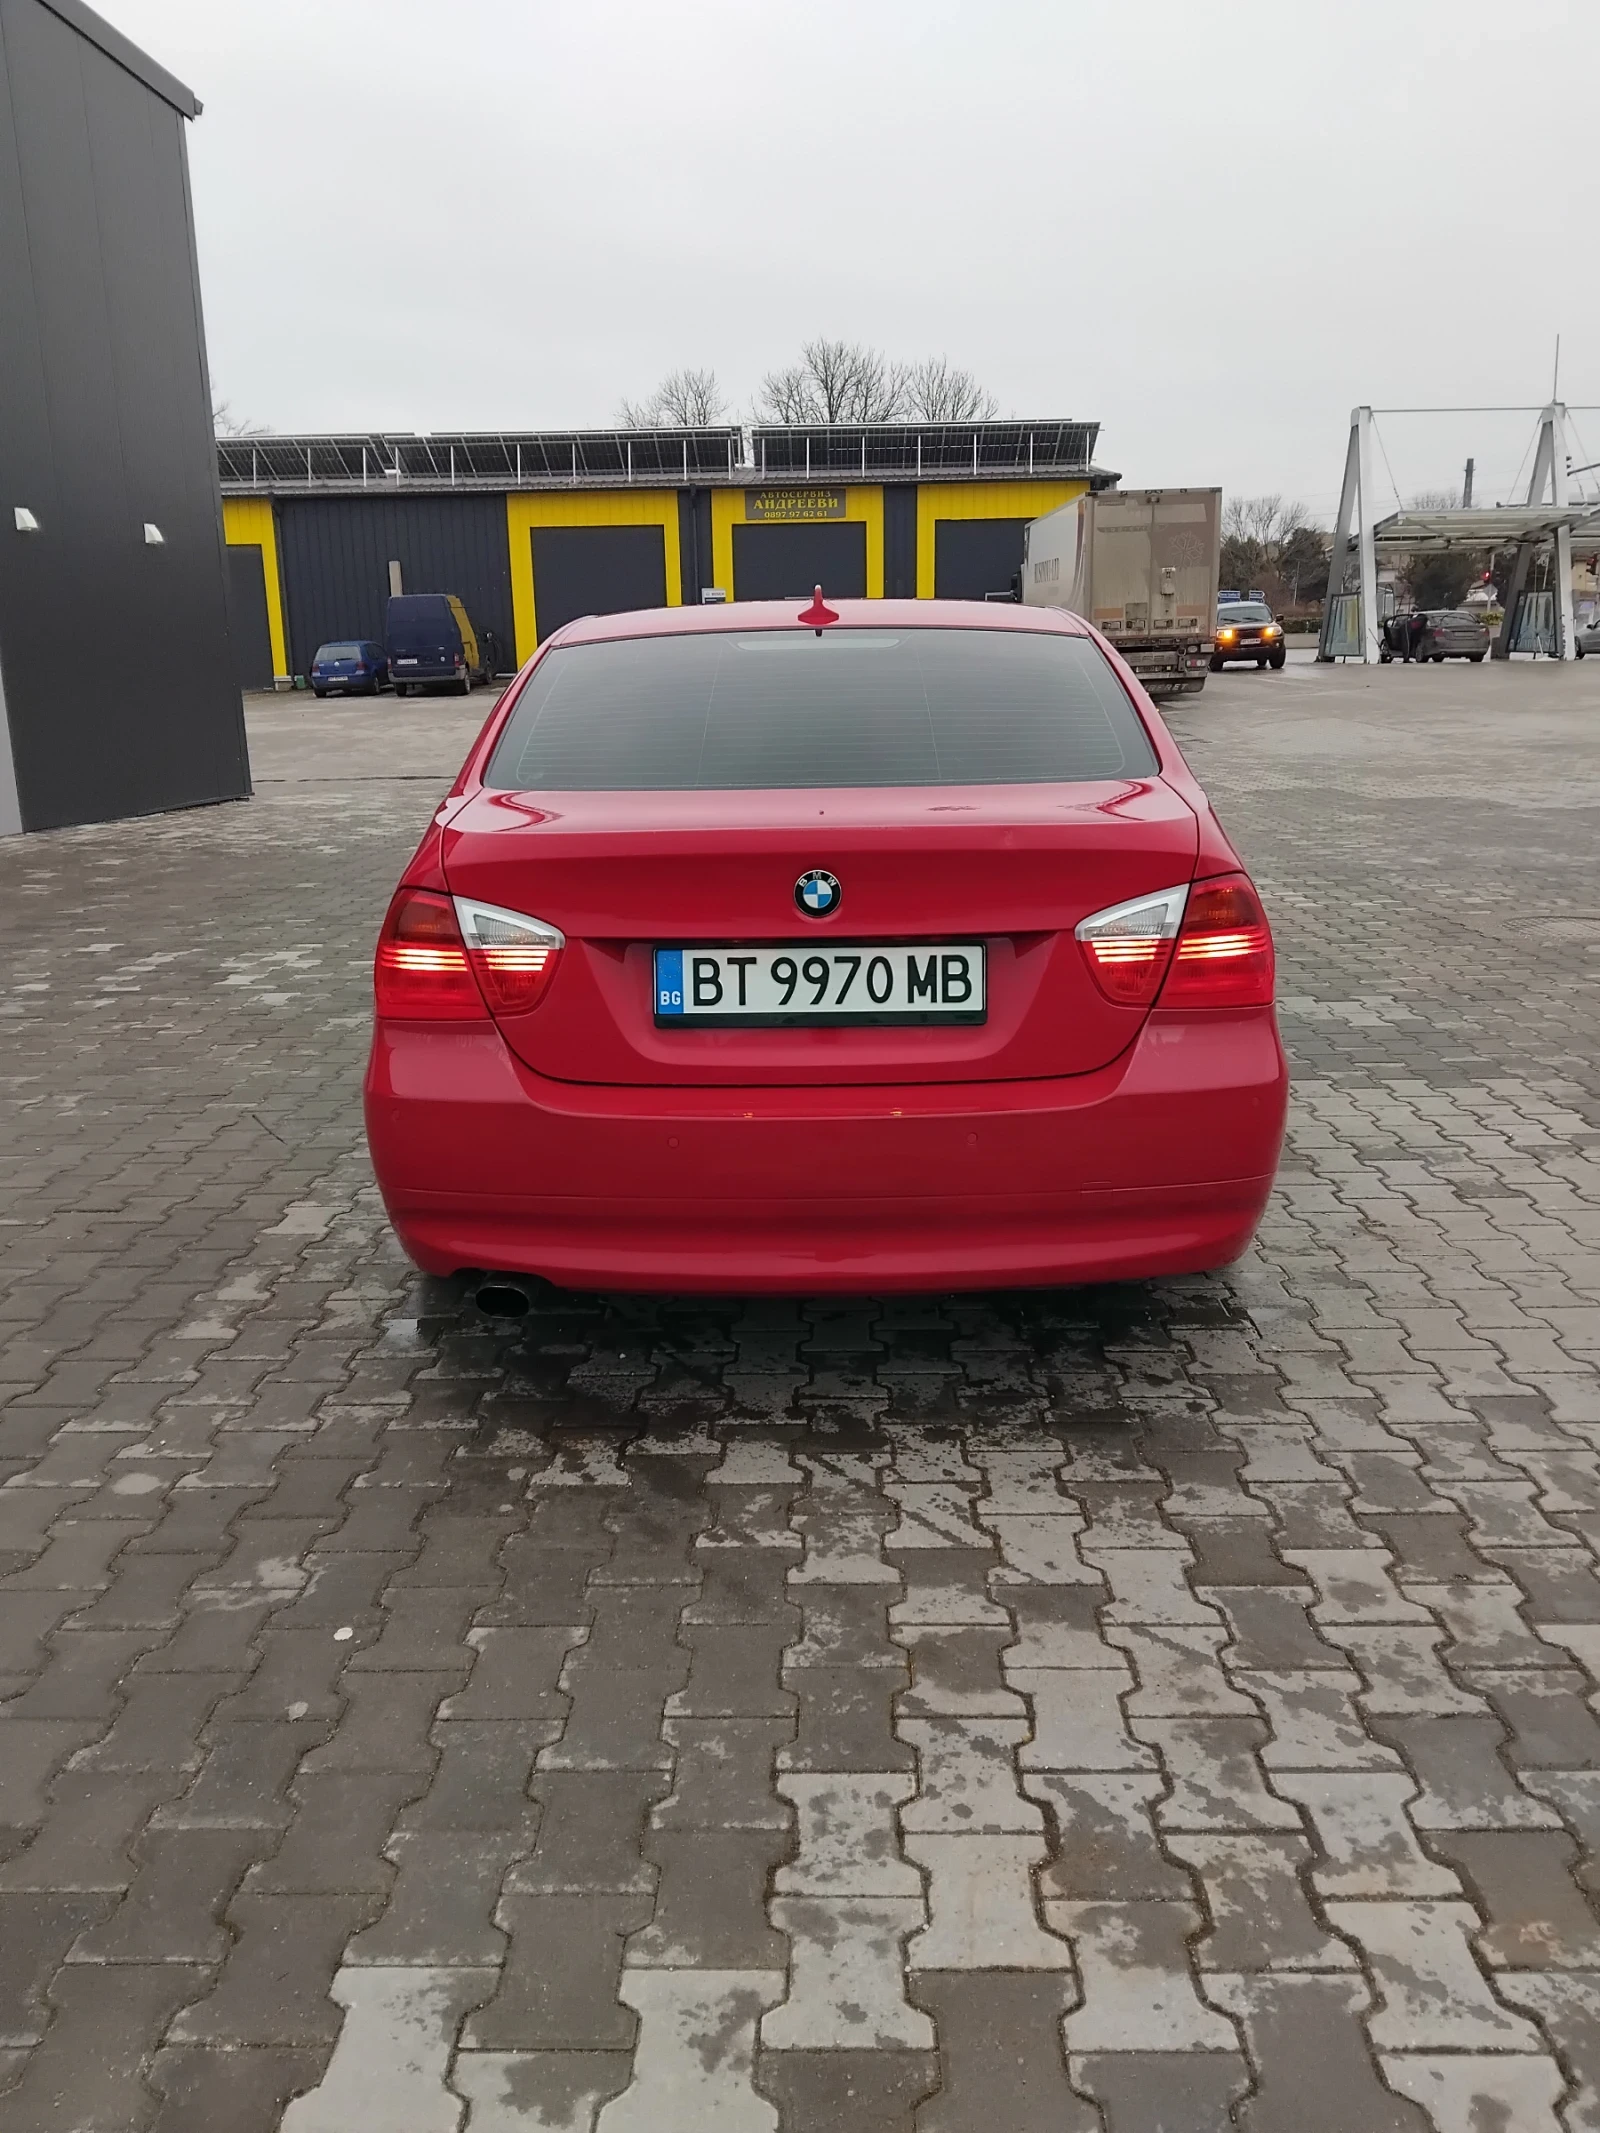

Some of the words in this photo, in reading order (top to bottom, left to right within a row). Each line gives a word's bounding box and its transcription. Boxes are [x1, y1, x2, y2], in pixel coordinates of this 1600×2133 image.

[760, 491, 831, 499] АВТОСЕРВИЗ
[753, 498, 838, 510] АНДРЕЕВИ
[1145, 683, 1189, 692] BERET
[798, 871, 838, 888] BMW
[692, 957, 757, 1007] BT
[770, 955, 894, 1006] 9970
[907, 954, 972, 1004] MB
[660, 990, 681, 1006] BG
